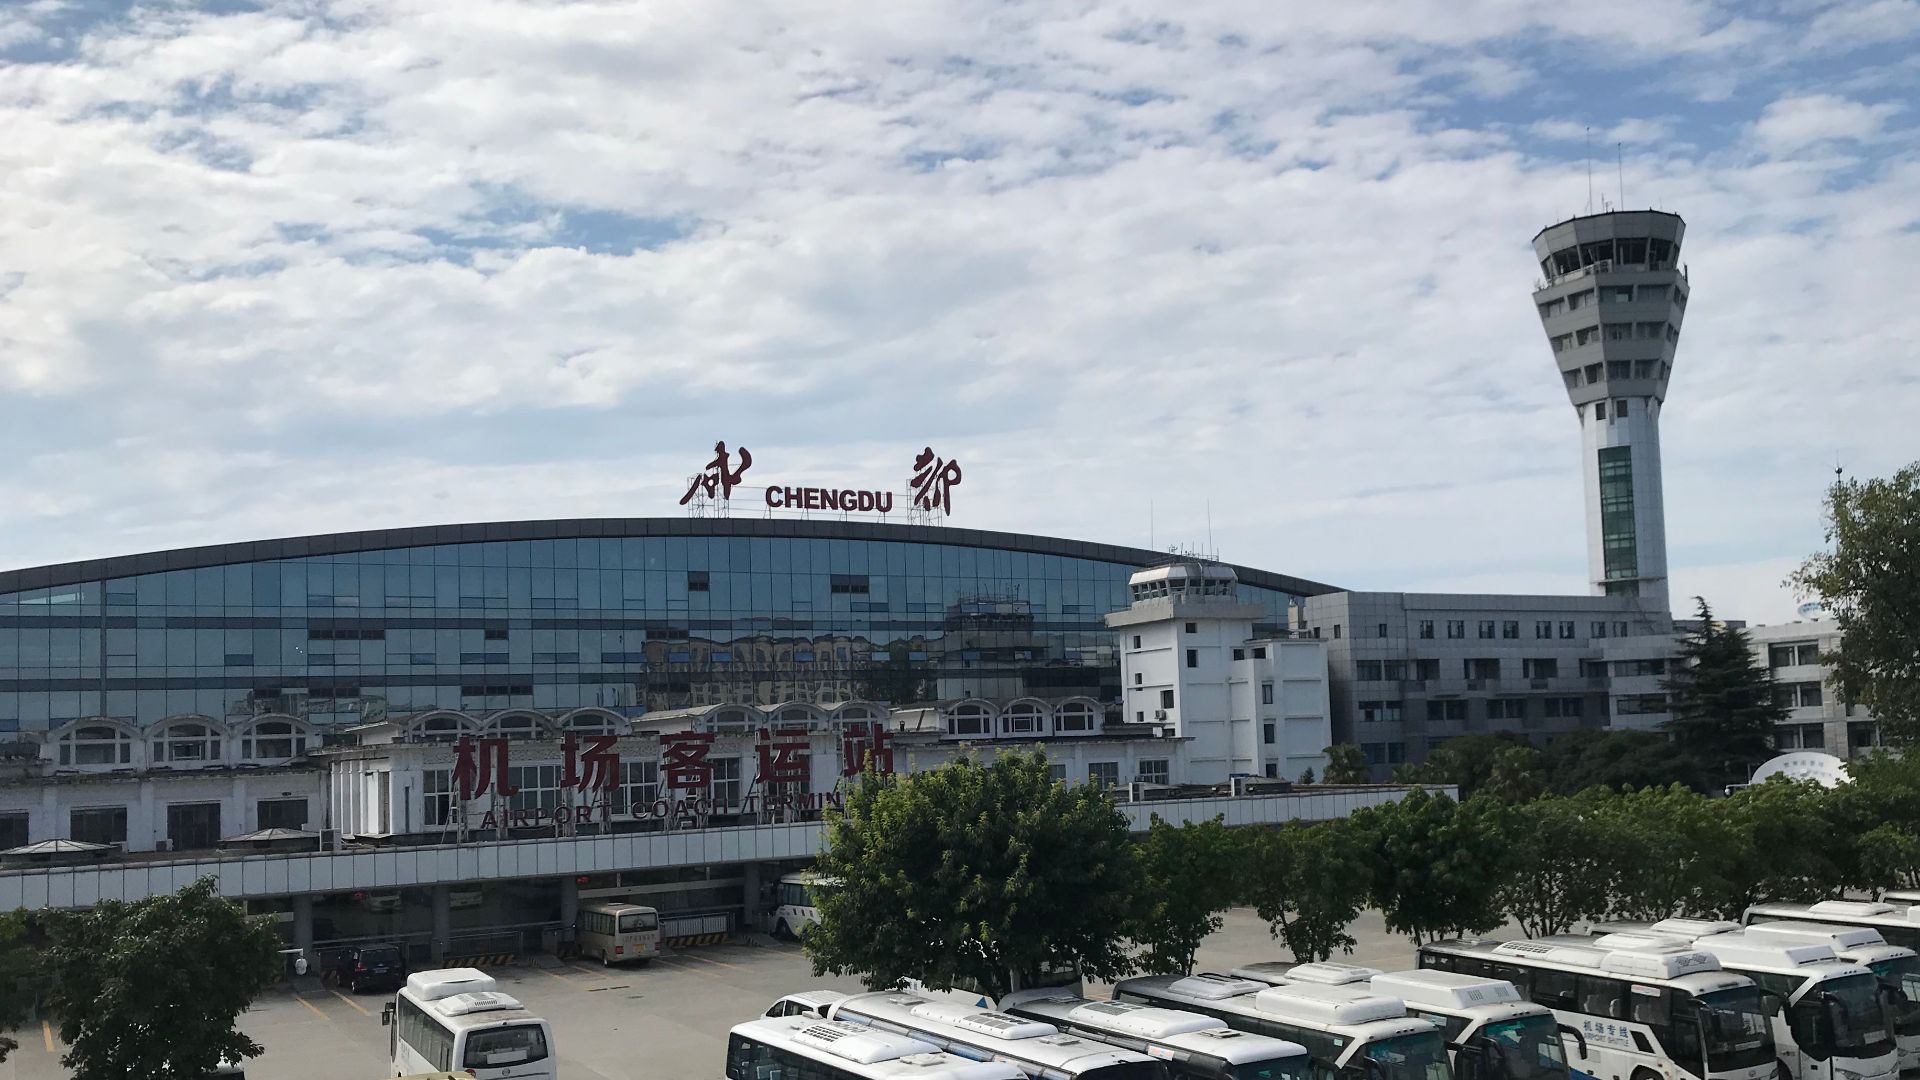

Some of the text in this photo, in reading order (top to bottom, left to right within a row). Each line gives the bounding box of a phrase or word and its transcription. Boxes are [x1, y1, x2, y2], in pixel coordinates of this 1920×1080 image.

[765, 485, 893, 513] CHENGDU
[452, 723, 894, 800] 机场客运站
[480, 801, 612, 829] AIRPORT
[631, 797, 728, 819] COACH
